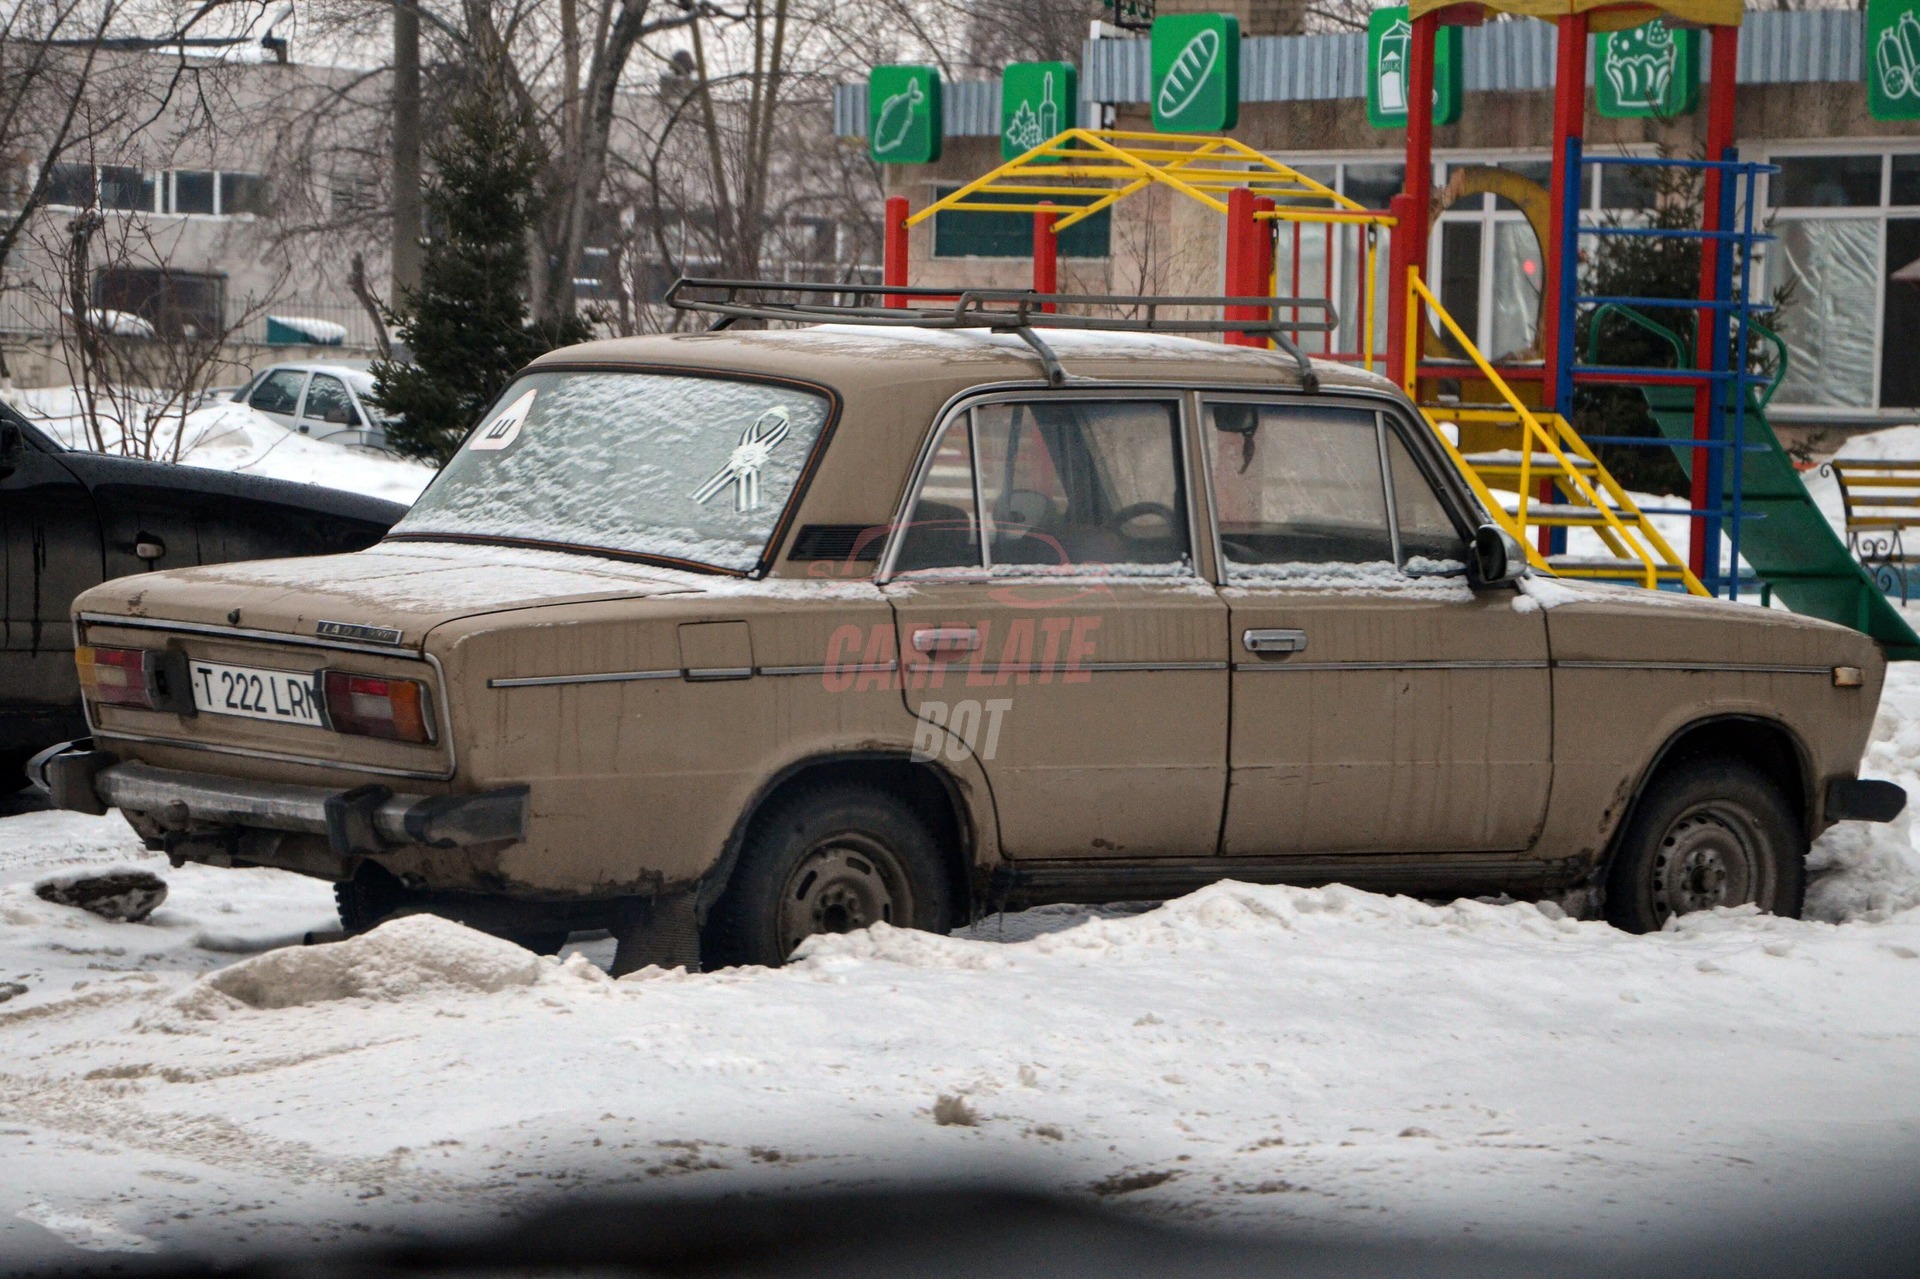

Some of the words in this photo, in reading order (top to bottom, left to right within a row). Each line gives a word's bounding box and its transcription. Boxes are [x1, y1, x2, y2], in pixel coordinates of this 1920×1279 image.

[1381, 60, 1400, 71] MILK
[197, 667, 212, 706] T
[222, 671, 267, 713] 222
